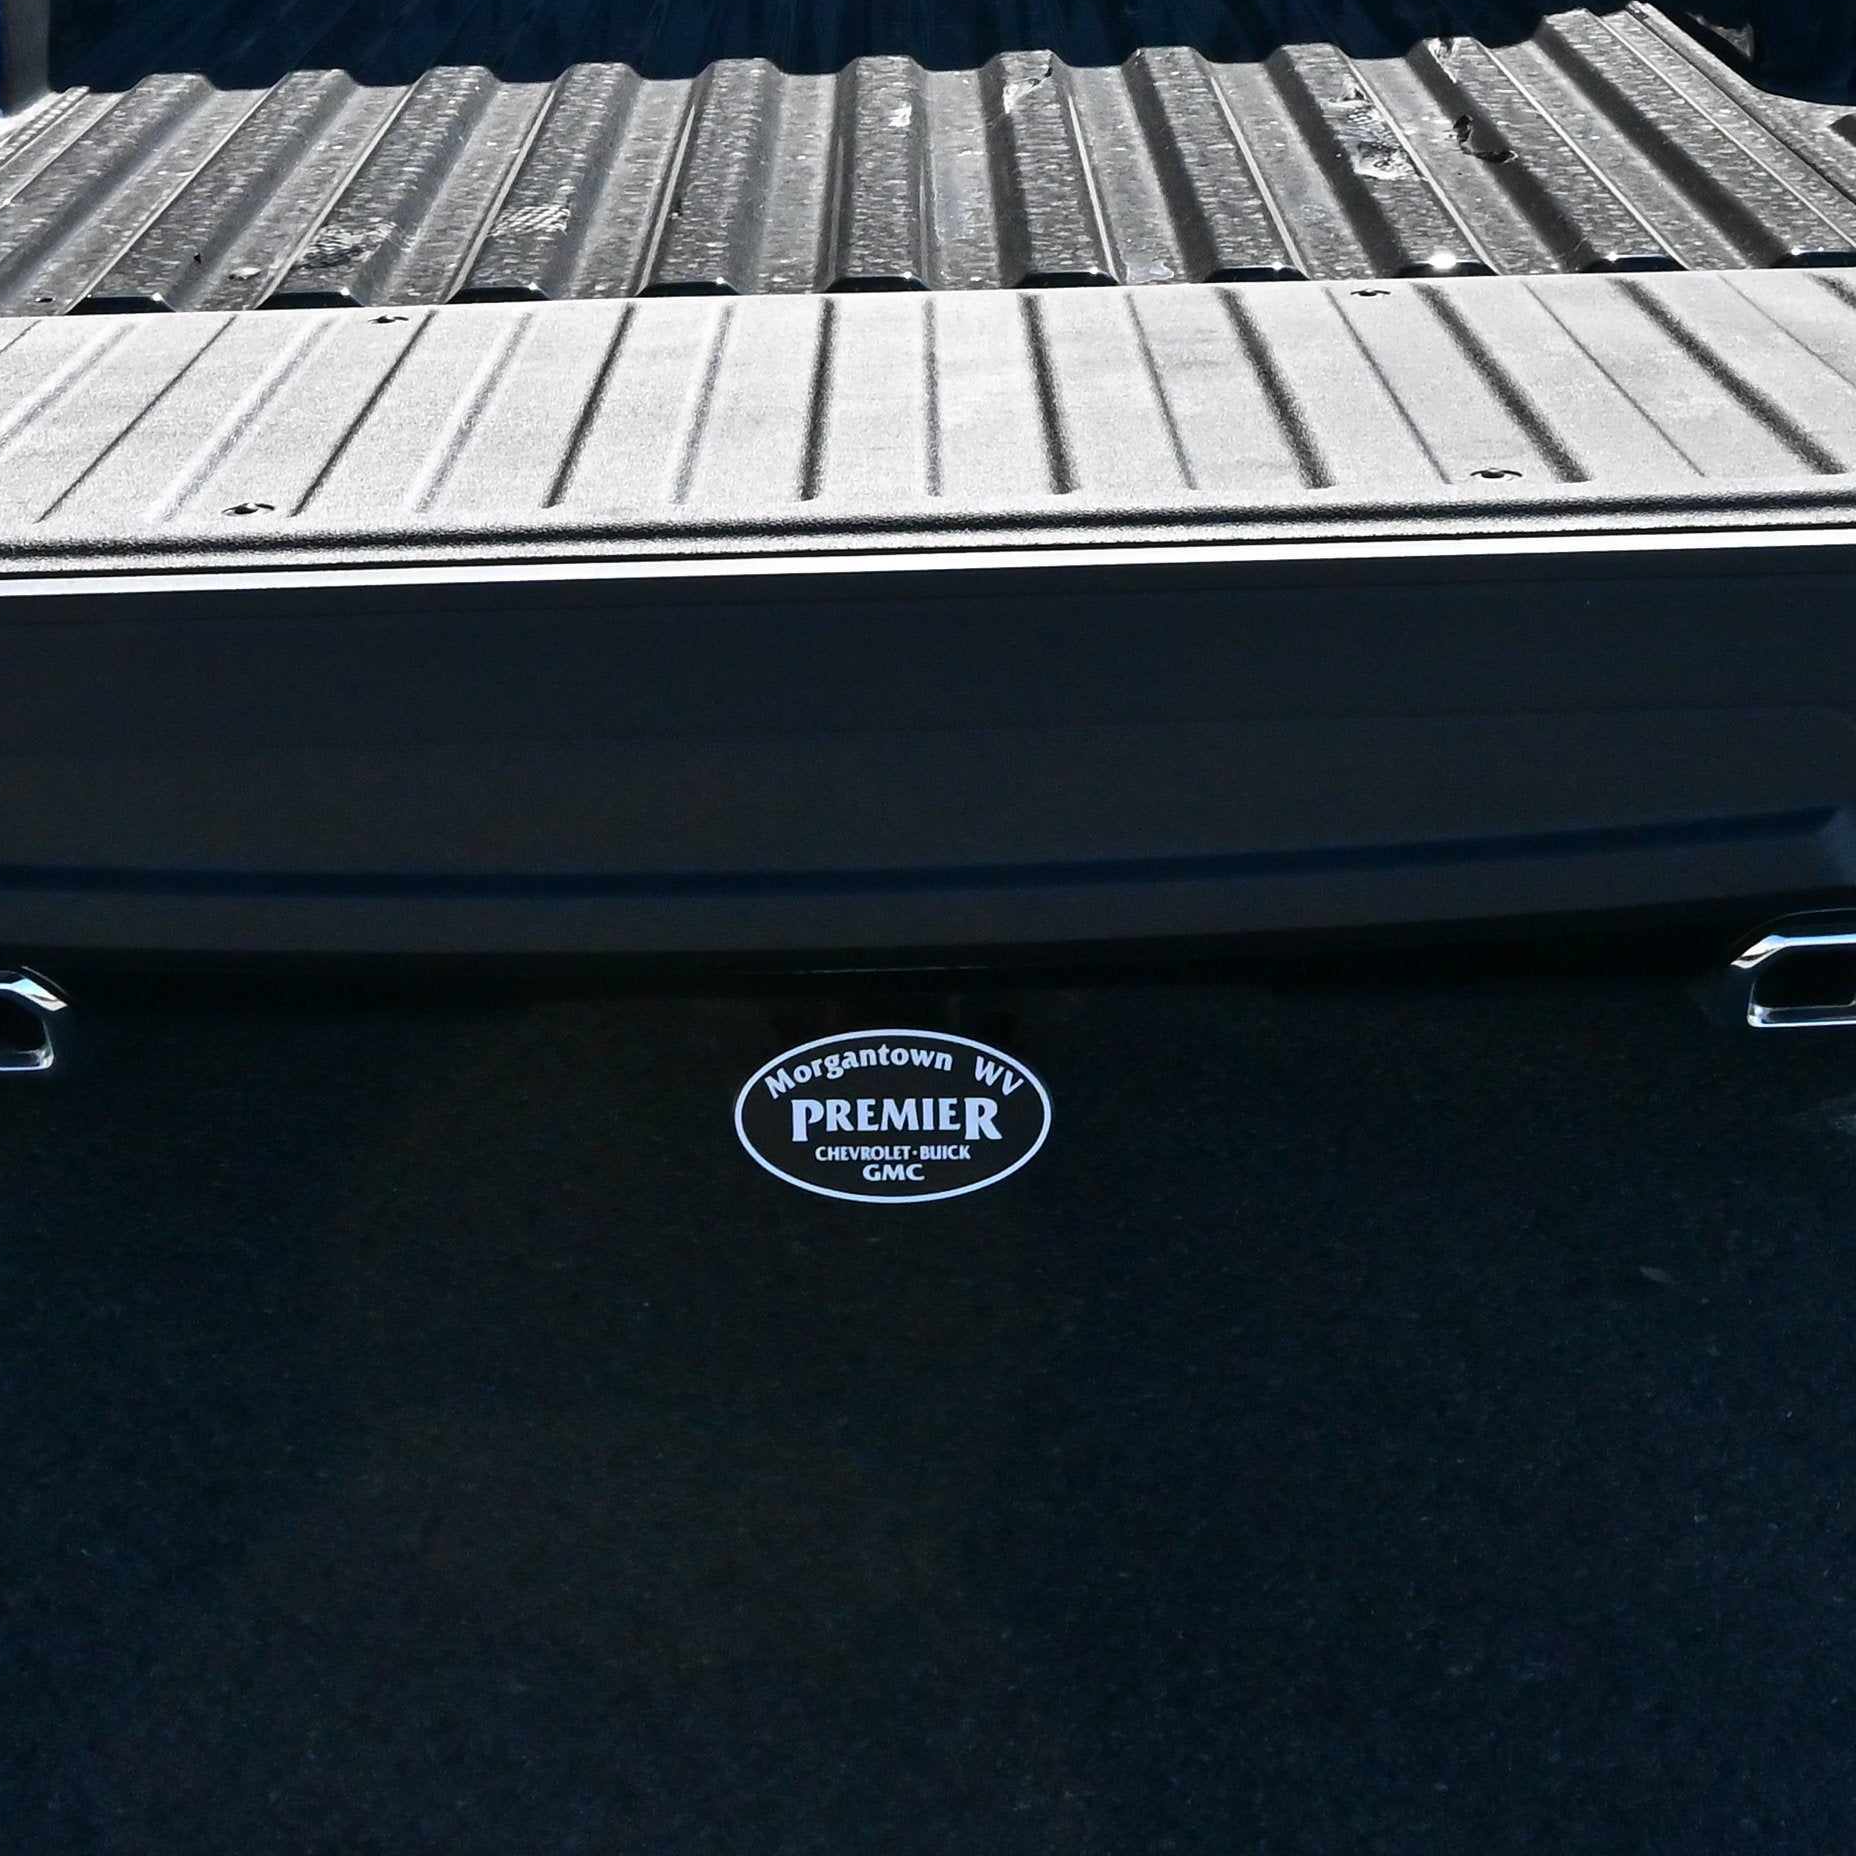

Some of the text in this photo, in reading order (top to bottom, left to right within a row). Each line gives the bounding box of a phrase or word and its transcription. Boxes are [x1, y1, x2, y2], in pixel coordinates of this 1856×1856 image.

[764, 1043, 1025, 1099] Morgantown WV
[790, 1097, 1003, 1143] PREMIER
[862, 1162, 925, 1182] GMC
